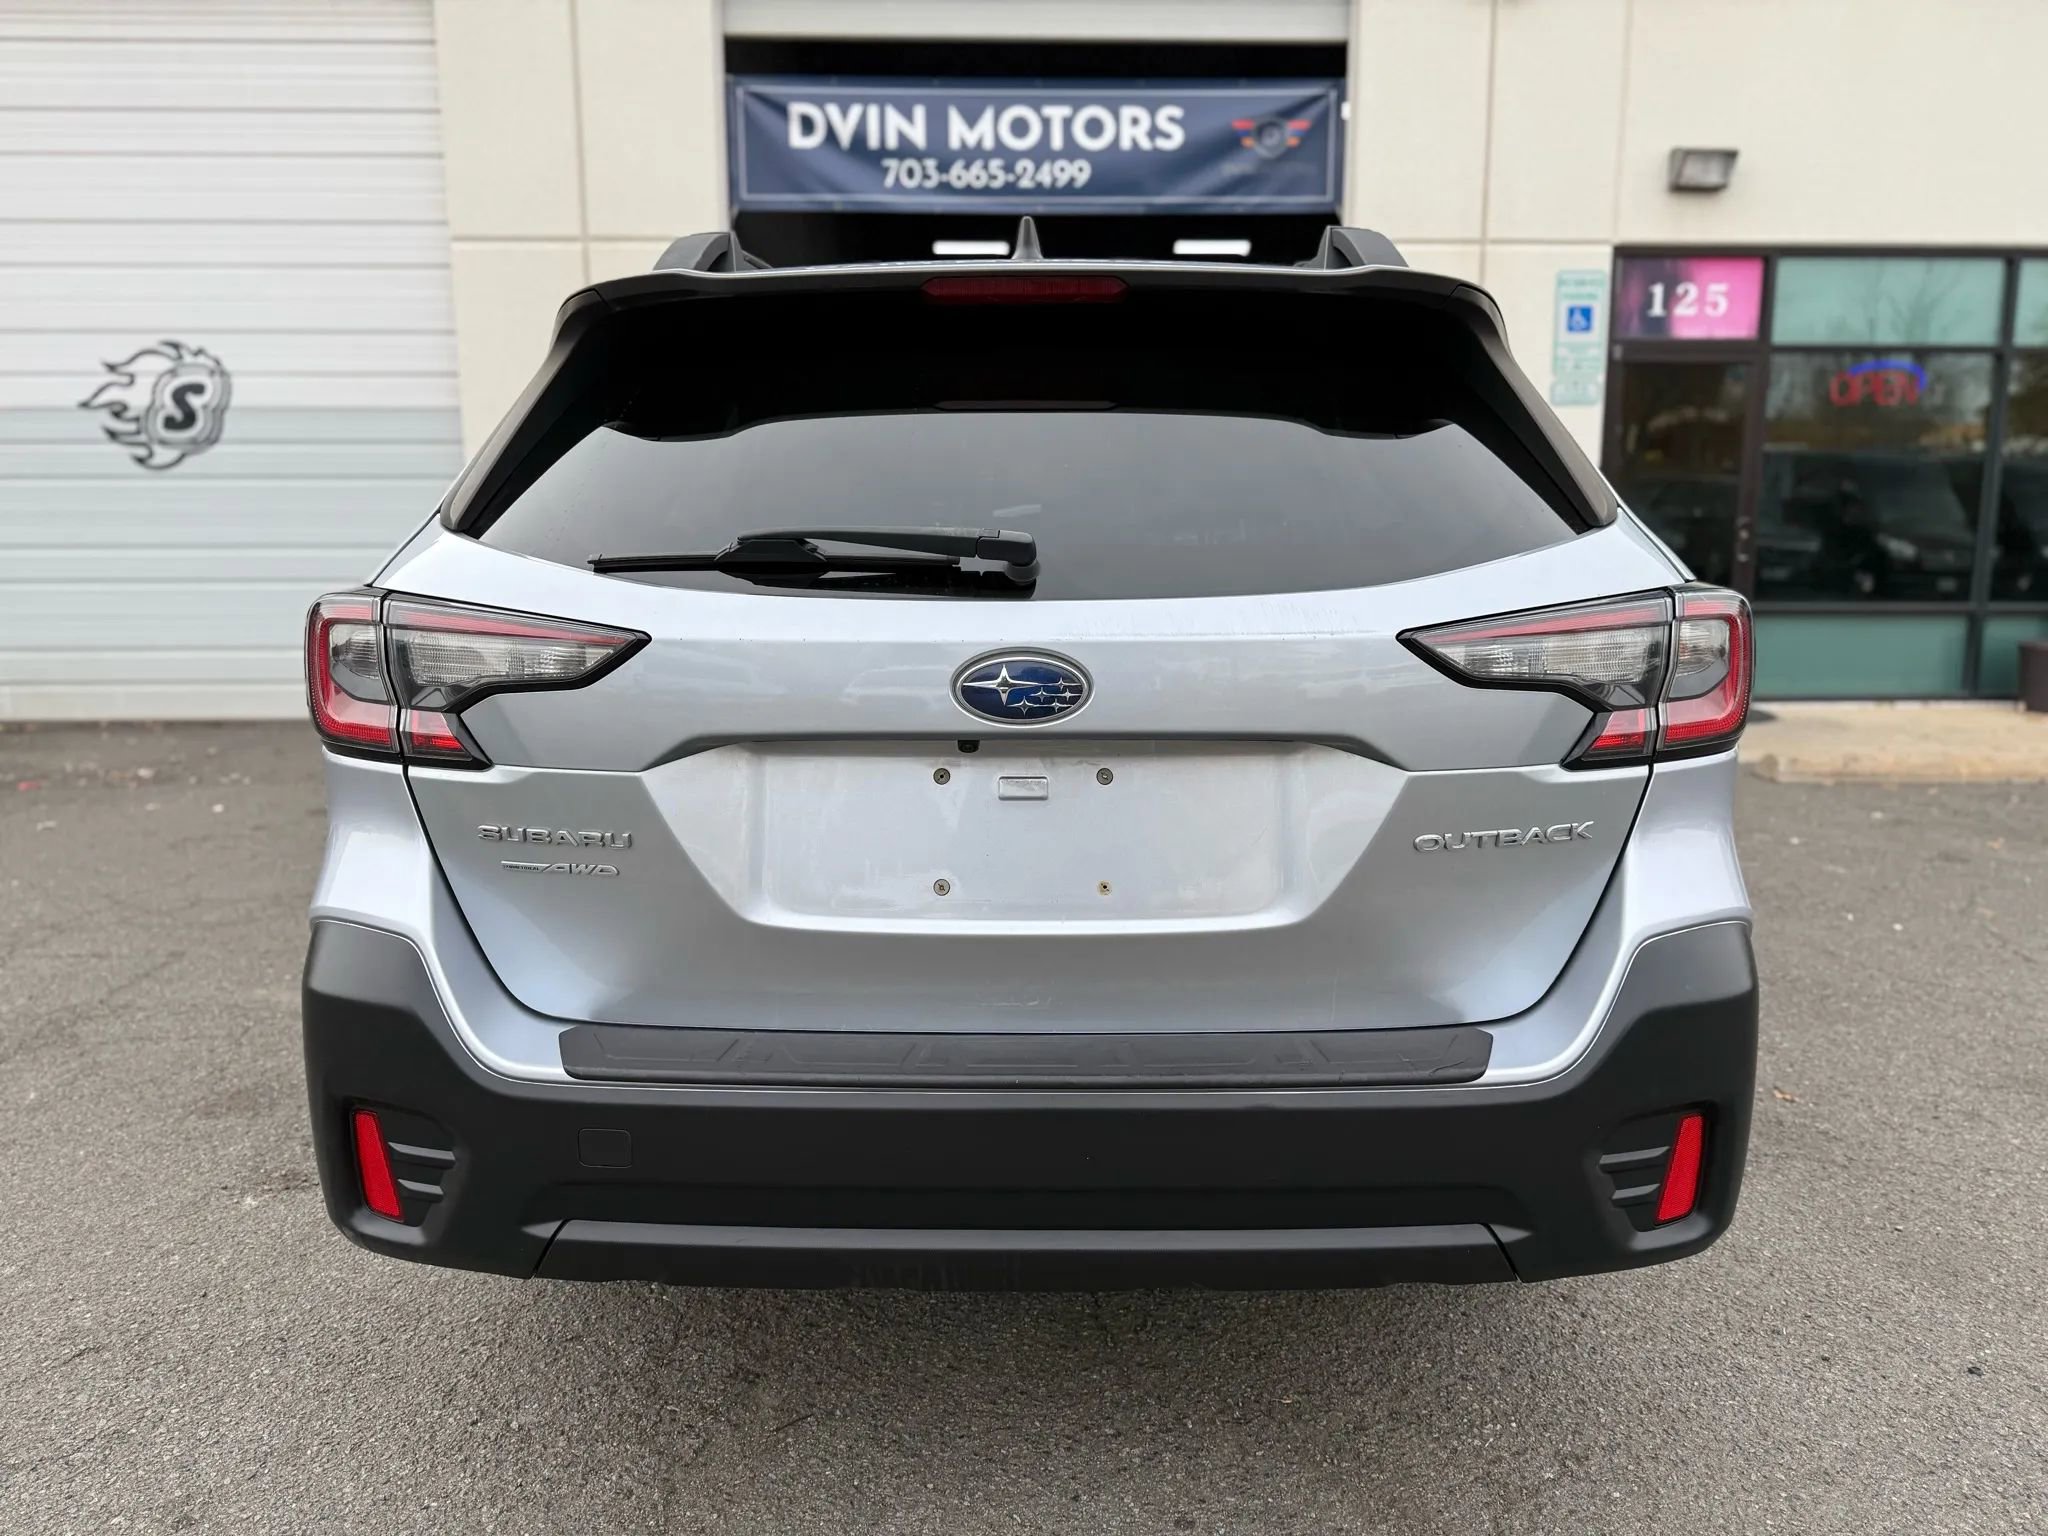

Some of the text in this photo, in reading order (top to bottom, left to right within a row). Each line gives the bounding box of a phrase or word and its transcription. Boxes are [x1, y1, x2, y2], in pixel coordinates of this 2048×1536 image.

[786, 102, 1186, 152] DVIN MOTORS
[880, 157, 1092, 190] 703-665-2499
[1646, 281, 1731, 318] 125
[1829, 369, 1919, 406] OPEN
[476, 824, 633, 849] SUBARU
[1413, 820, 1595, 852] OUTBACK
[542, 863, 620, 876] AWD
